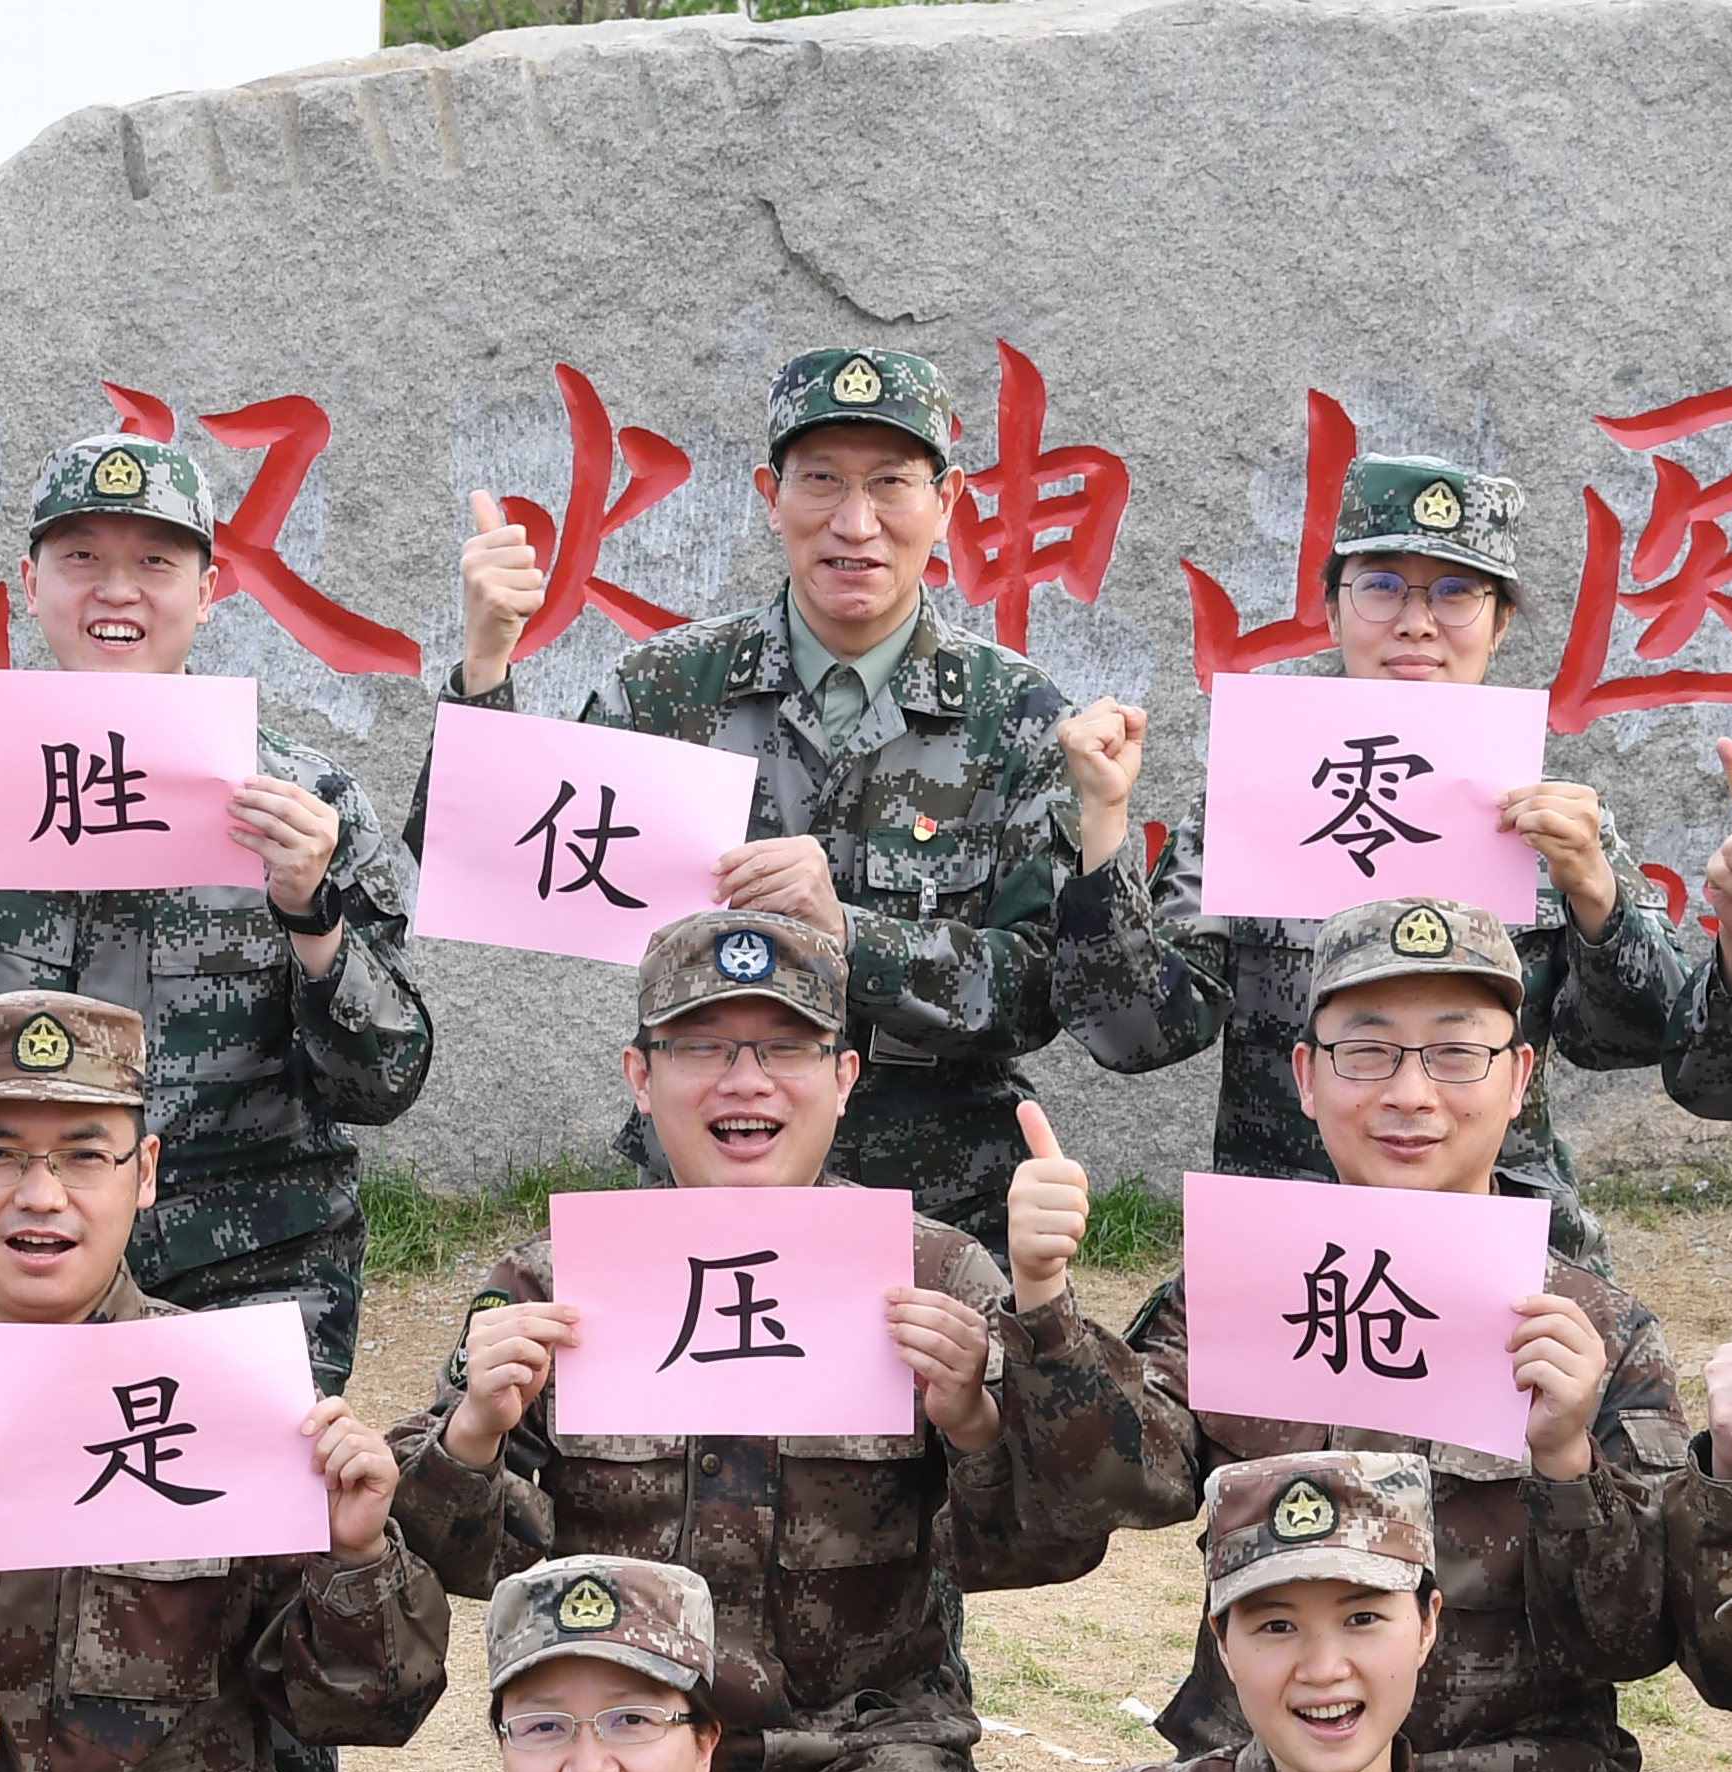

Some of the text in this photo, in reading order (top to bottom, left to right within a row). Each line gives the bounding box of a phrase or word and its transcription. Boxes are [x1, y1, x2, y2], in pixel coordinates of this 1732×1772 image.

[29, 731, 170, 846] 胜
[514, 780, 648, 909] 仗
[1300, 735, 1442, 878] 零
[656, 1250, 806, 1373] 压
[1281, 1242, 1440, 1380] 舱
[73, 1376, 226, 1506] 是
